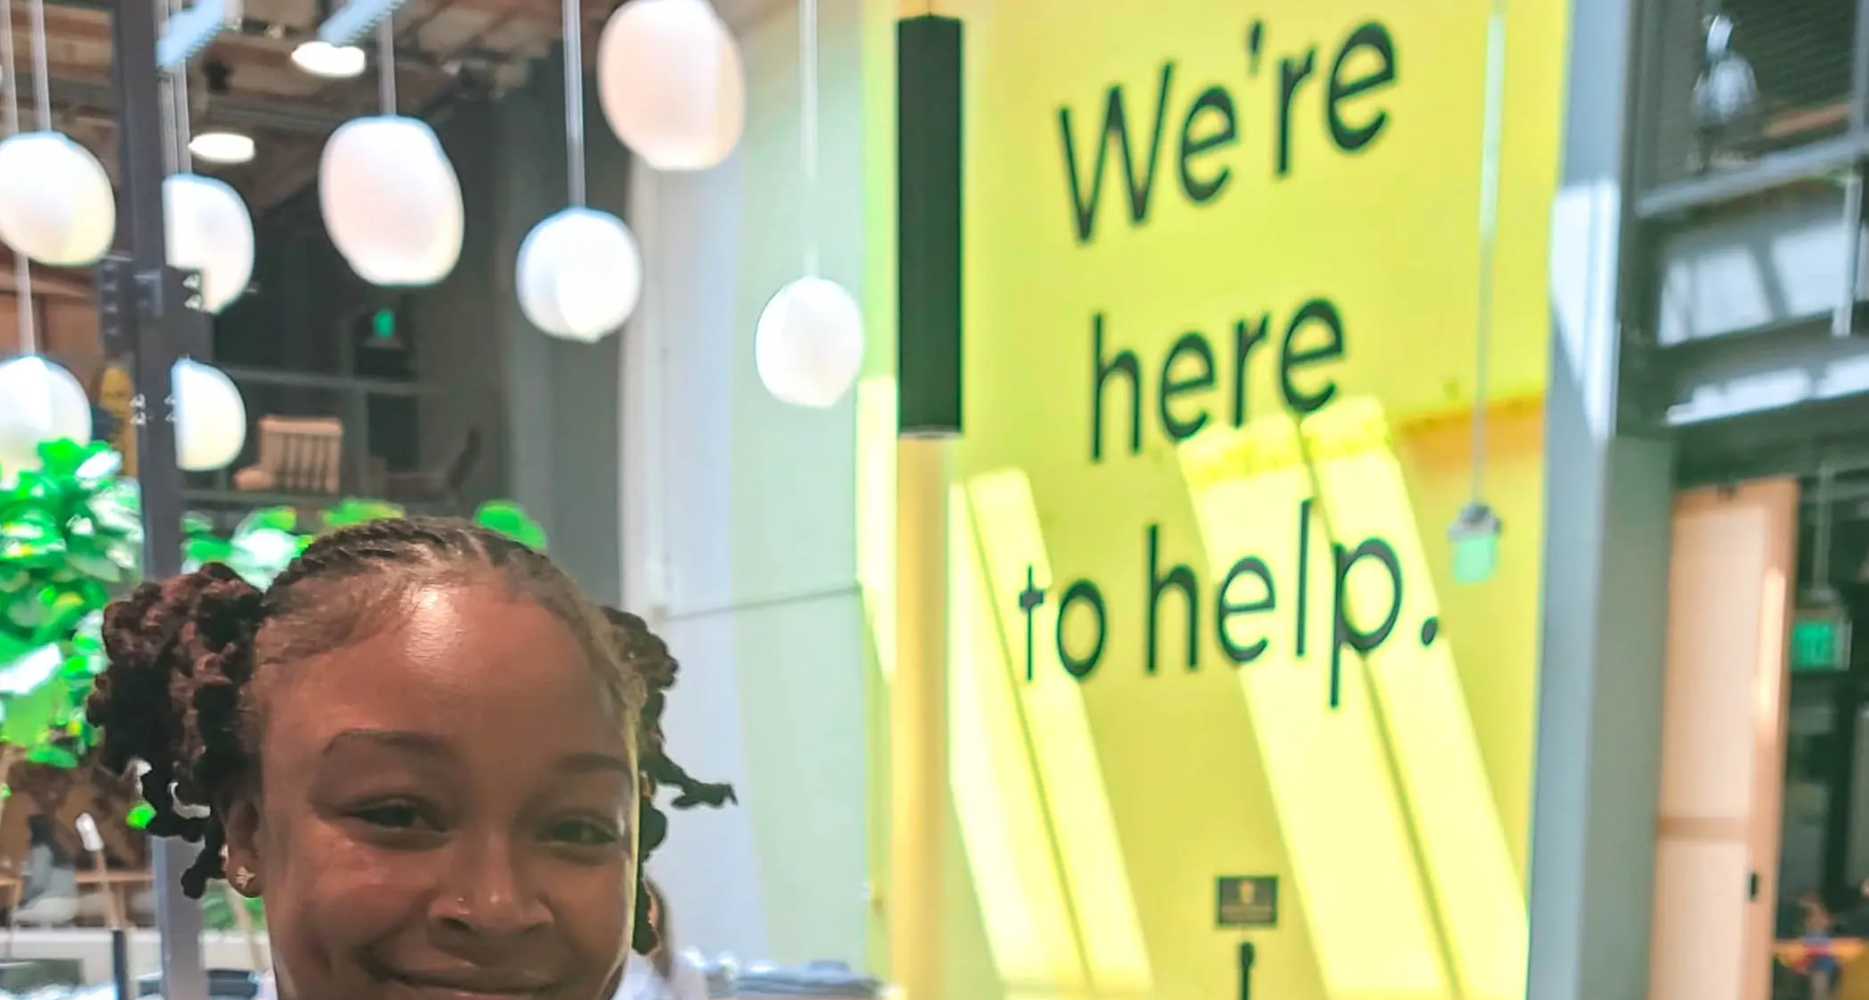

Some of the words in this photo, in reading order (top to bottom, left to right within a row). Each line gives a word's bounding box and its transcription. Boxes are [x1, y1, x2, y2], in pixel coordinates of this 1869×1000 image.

[1058, 20, 1400, 244] We're
[1092, 297, 1346, 462] here
[1019, 564, 1107, 682] to
[1145, 498, 1439, 709] help.
